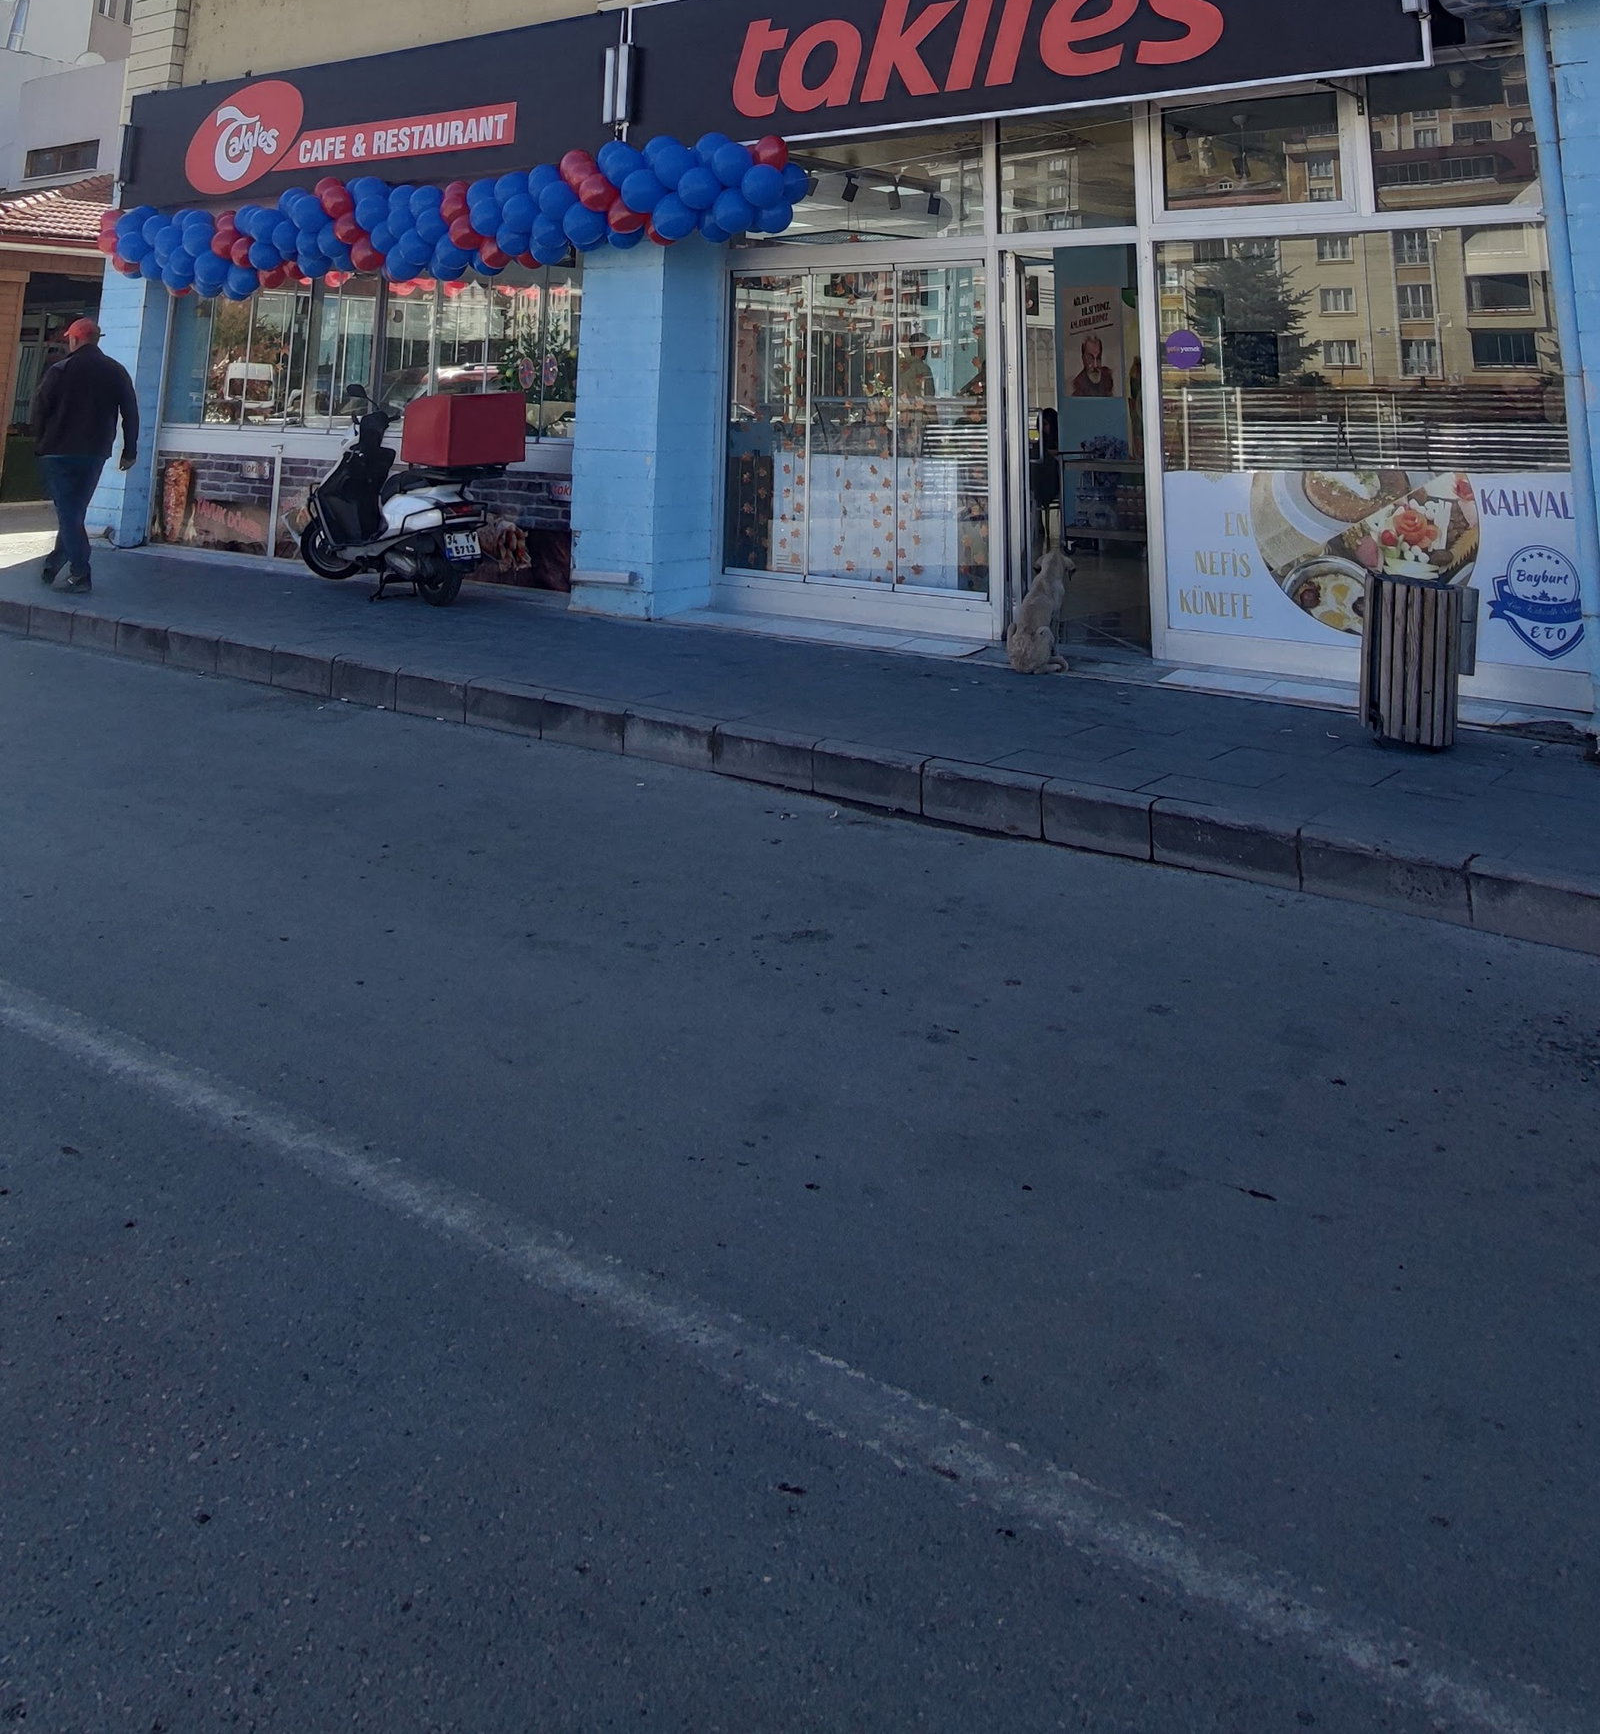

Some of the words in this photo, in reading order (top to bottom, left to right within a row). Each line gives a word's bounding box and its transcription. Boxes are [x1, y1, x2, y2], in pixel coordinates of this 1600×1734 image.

[299, 135, 347, 163] CAFE
[351, 132, 366, 158] &
[372, 113, 508, 155] RESTAURANT
[1481, 489, 1575, 520] KAHVAL
[1224, 512, 1249, 537] EN
[1195, 548, 1251, 578] NEFİS
[1516, 570, 1568, 587] Bayburt
[1179, 586, 1253, 619] KÜNEFE
